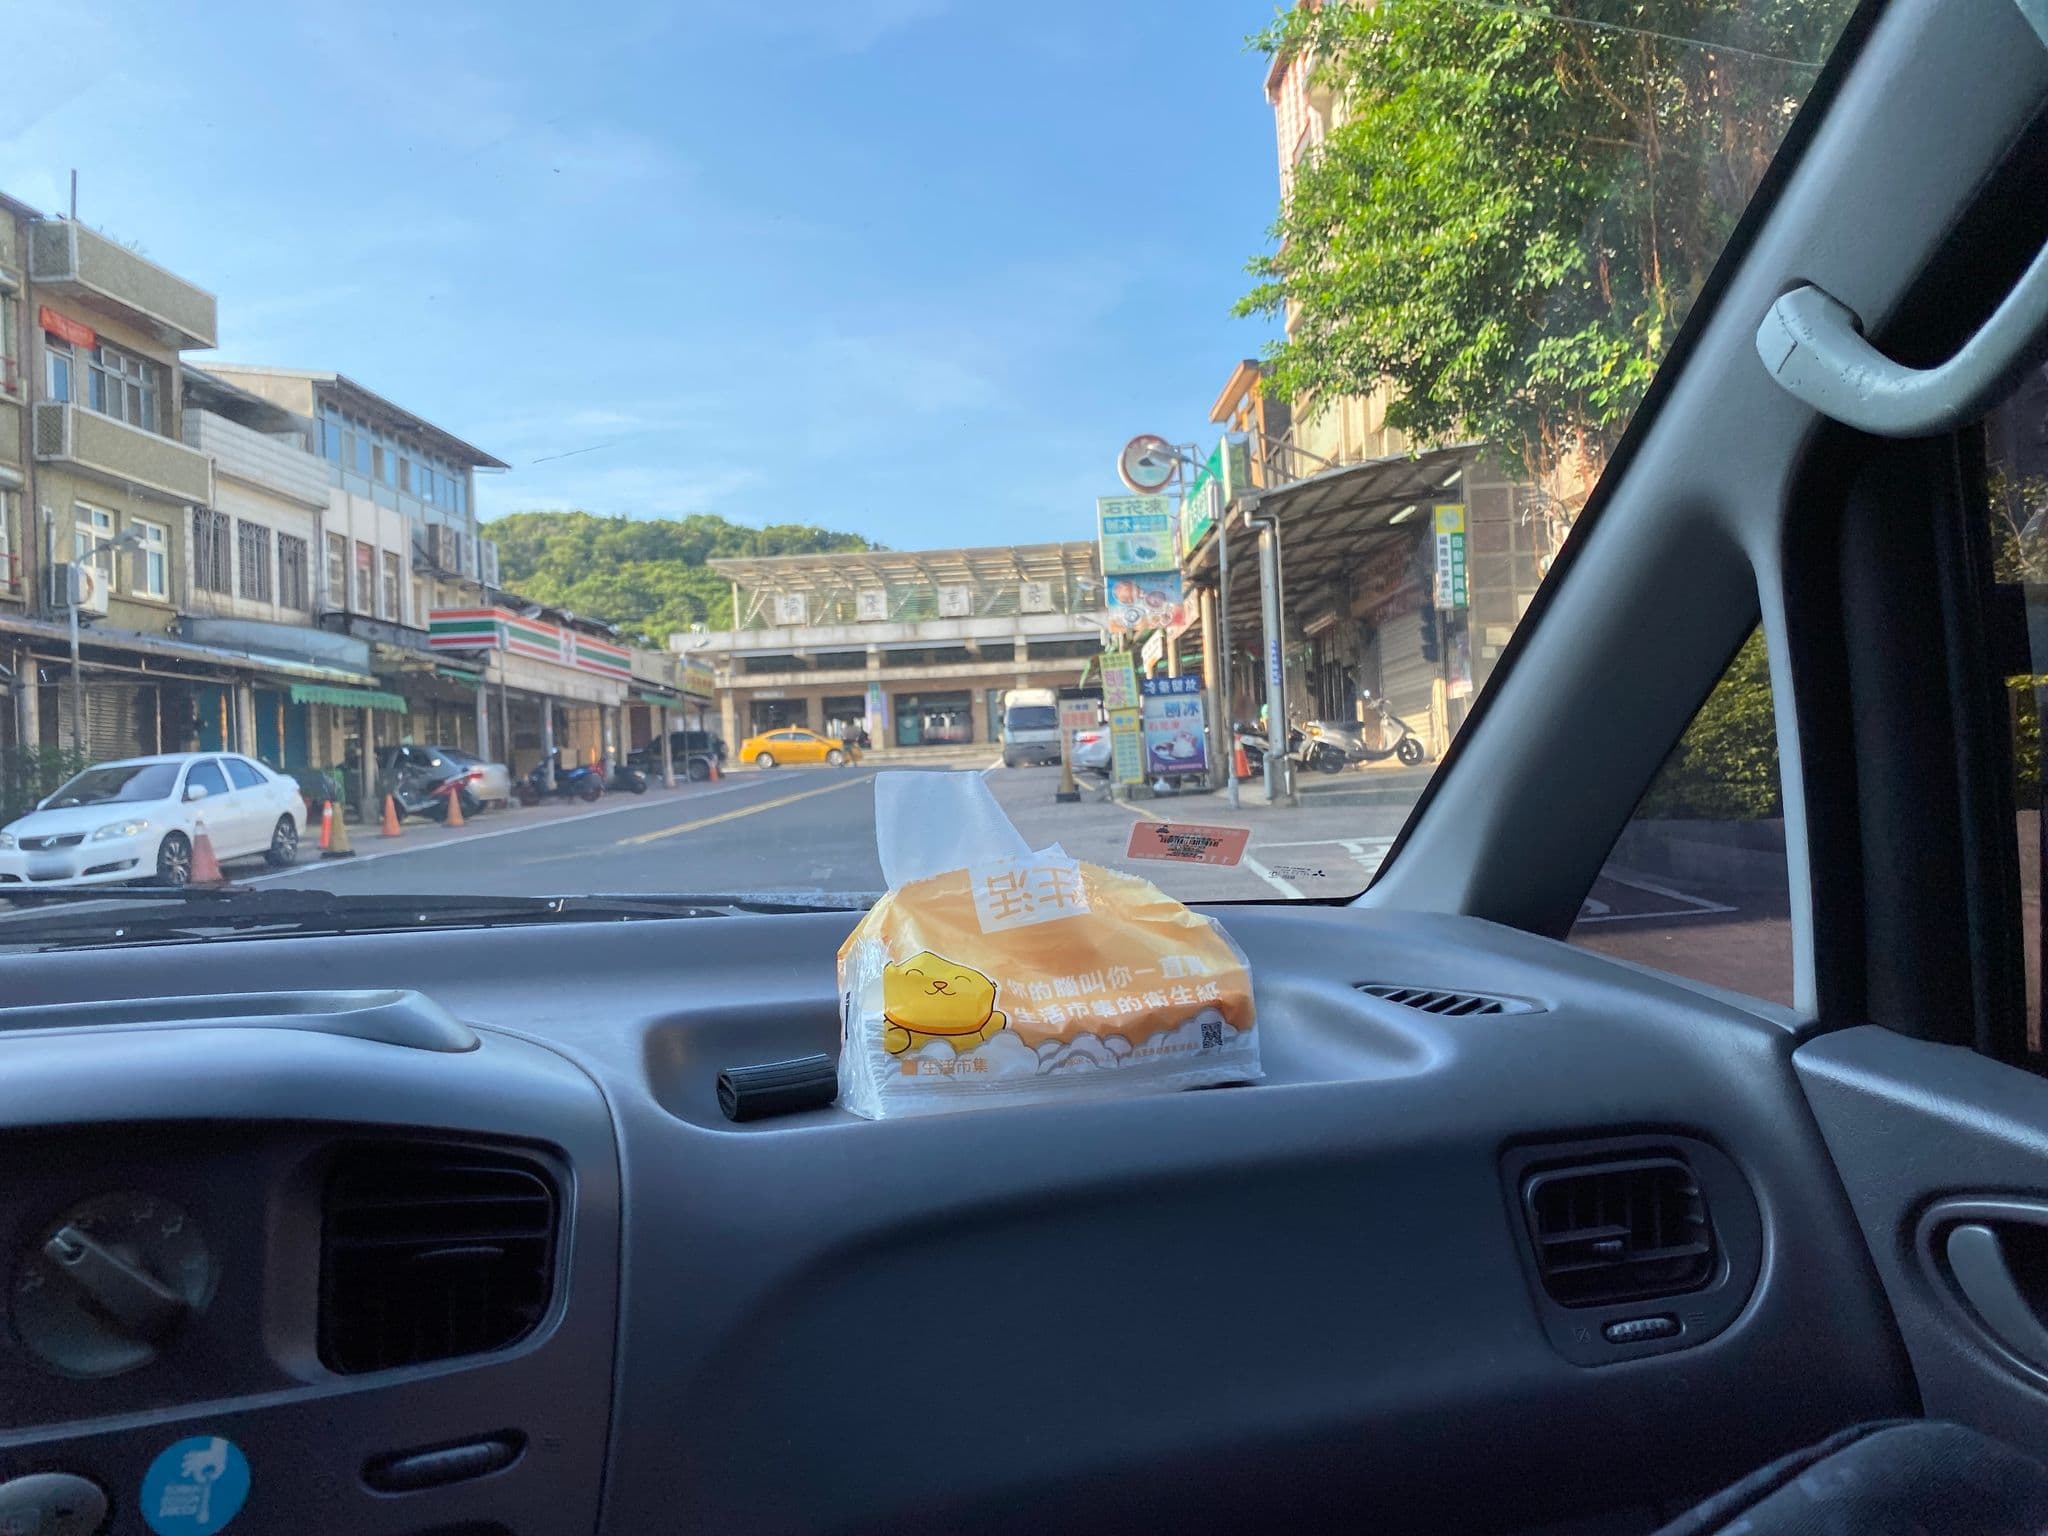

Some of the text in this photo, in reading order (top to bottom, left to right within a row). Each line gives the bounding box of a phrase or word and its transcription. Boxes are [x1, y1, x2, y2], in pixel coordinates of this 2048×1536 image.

[1164, 700, 1200, 718] 刨冰
[1014, 981, 1222, 1025] 生活市集的衛生紙
[923, 1056, 989, 1076] 生活市集
